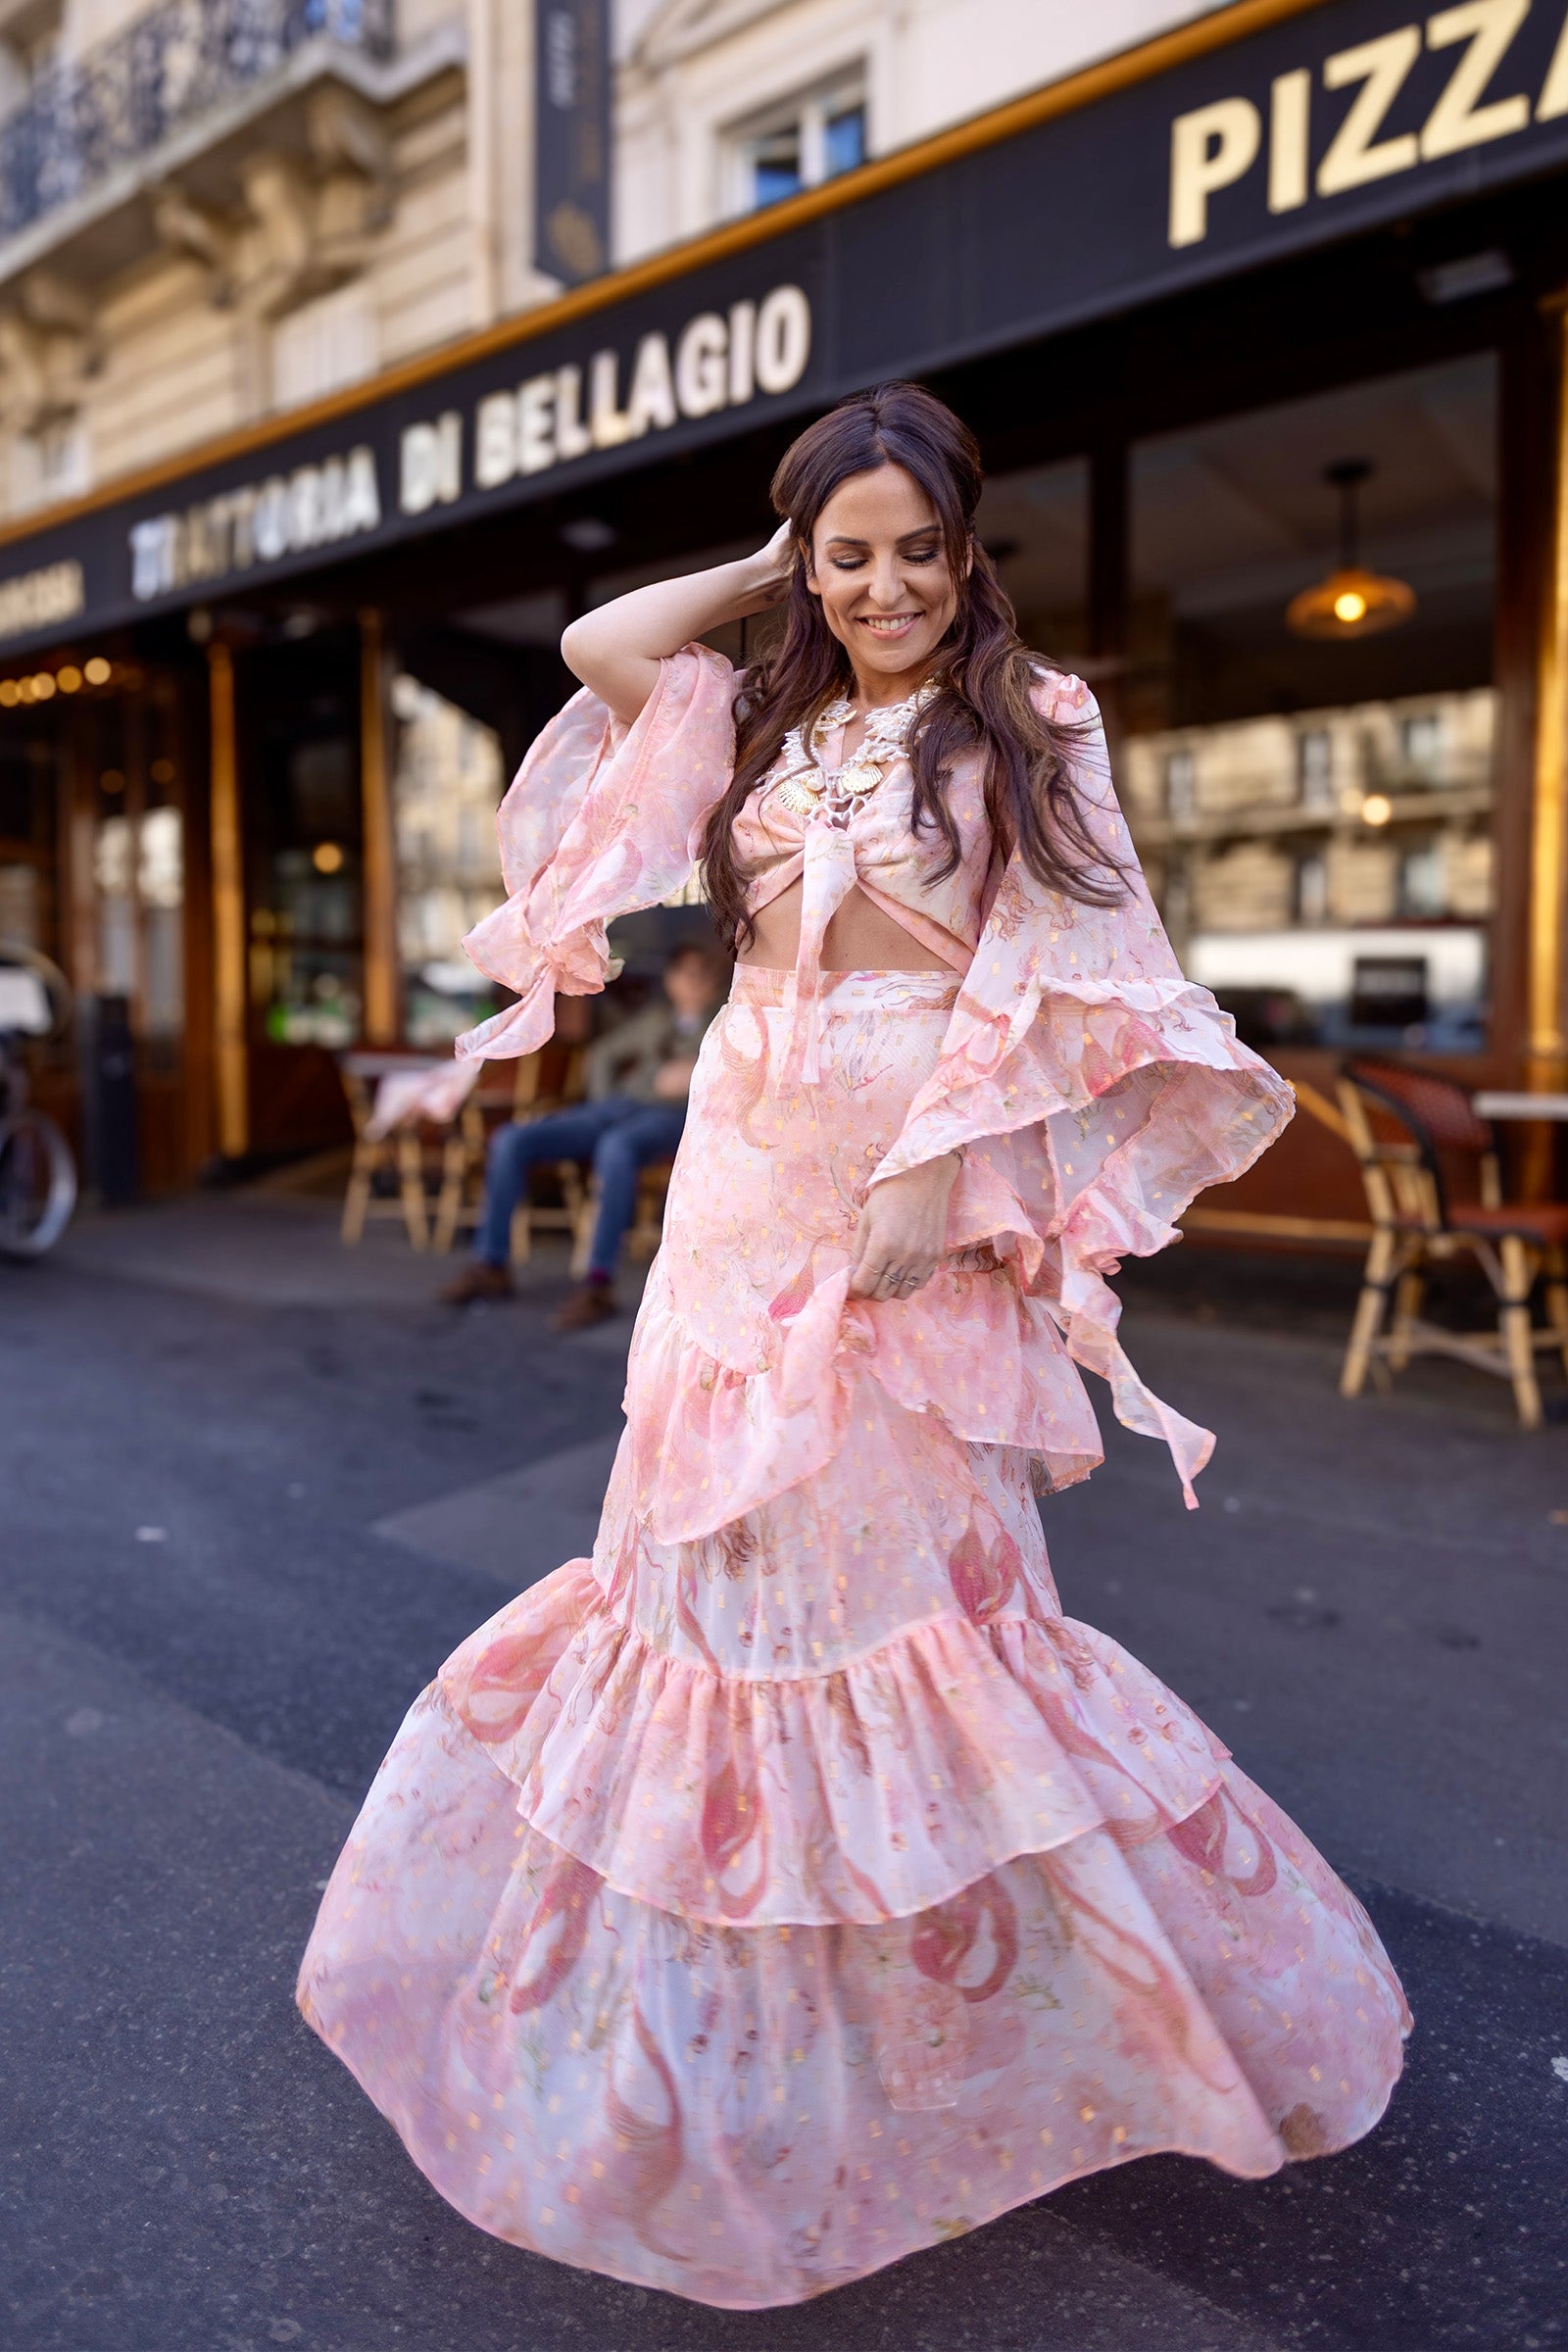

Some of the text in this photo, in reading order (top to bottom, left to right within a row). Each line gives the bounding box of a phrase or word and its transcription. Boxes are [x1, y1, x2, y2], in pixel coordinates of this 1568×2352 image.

[1168, 0, 1568, 249] PIZZ
[401, 410, 462, 514] DI
[476, 284, 810, 489] BELLAGIO
